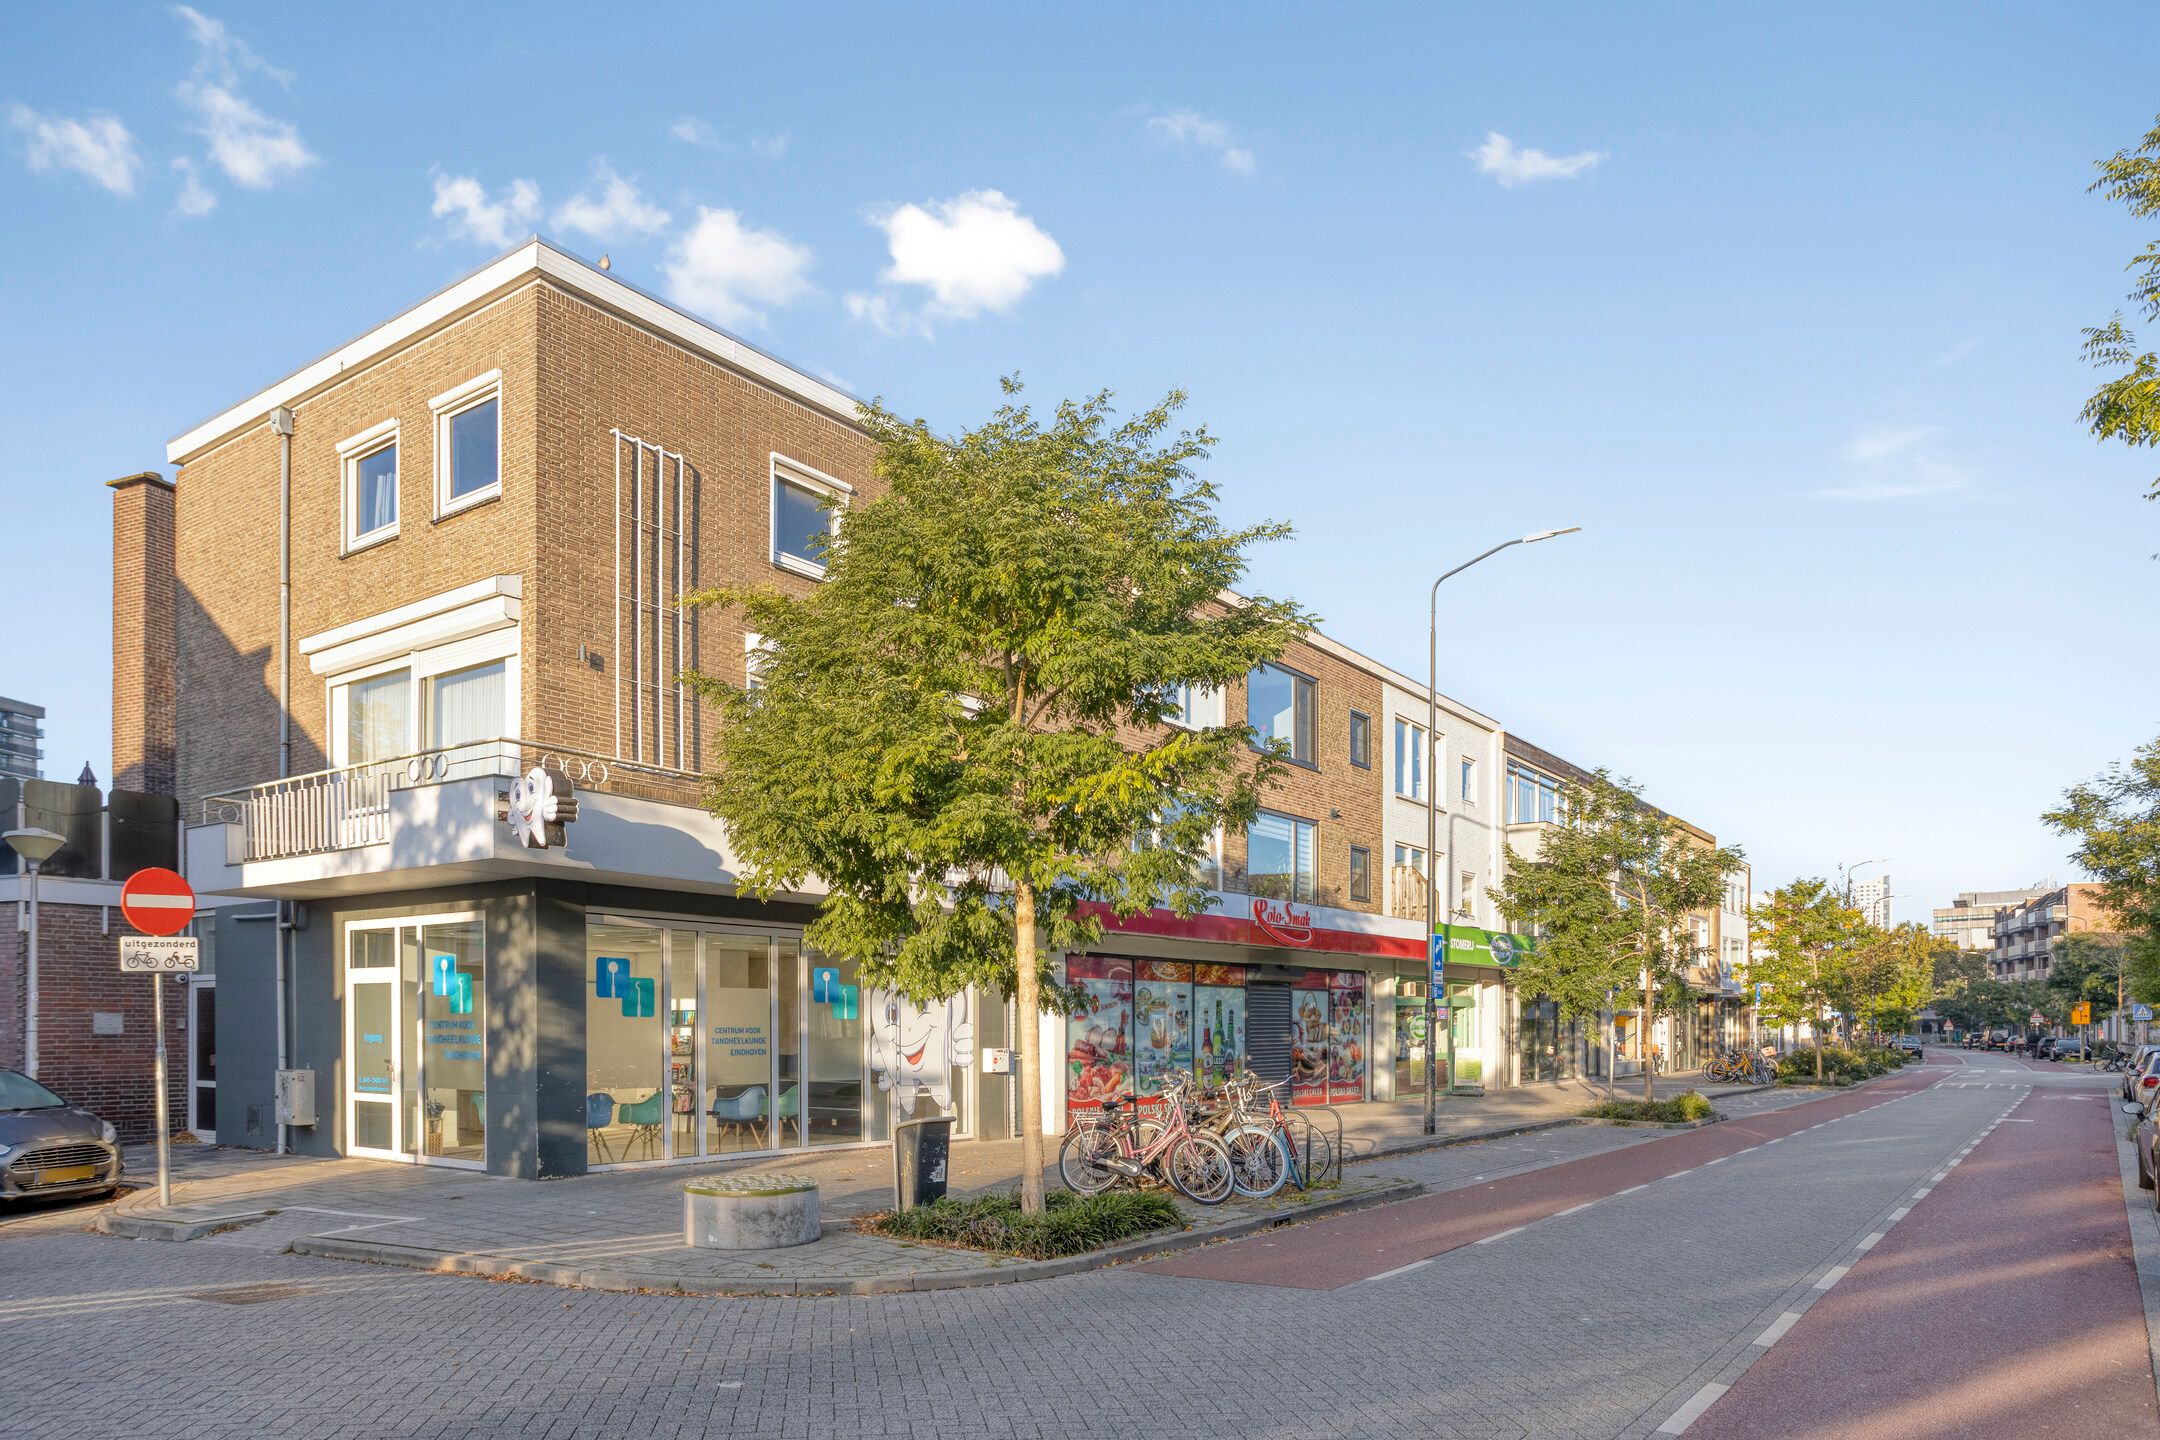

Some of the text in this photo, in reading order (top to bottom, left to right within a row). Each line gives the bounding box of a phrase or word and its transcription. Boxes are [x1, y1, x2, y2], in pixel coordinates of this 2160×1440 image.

[125, 940, 196, 950] uitgezonderd
[1450, 938, 1474, 951] STOMERIJ
[429, 1020, 457, 1030] CENTRUM
[427, 1034, 480, 1044] TANDHEELKUNDE
[1138, 1104, 1162, 1115] POLSKI
